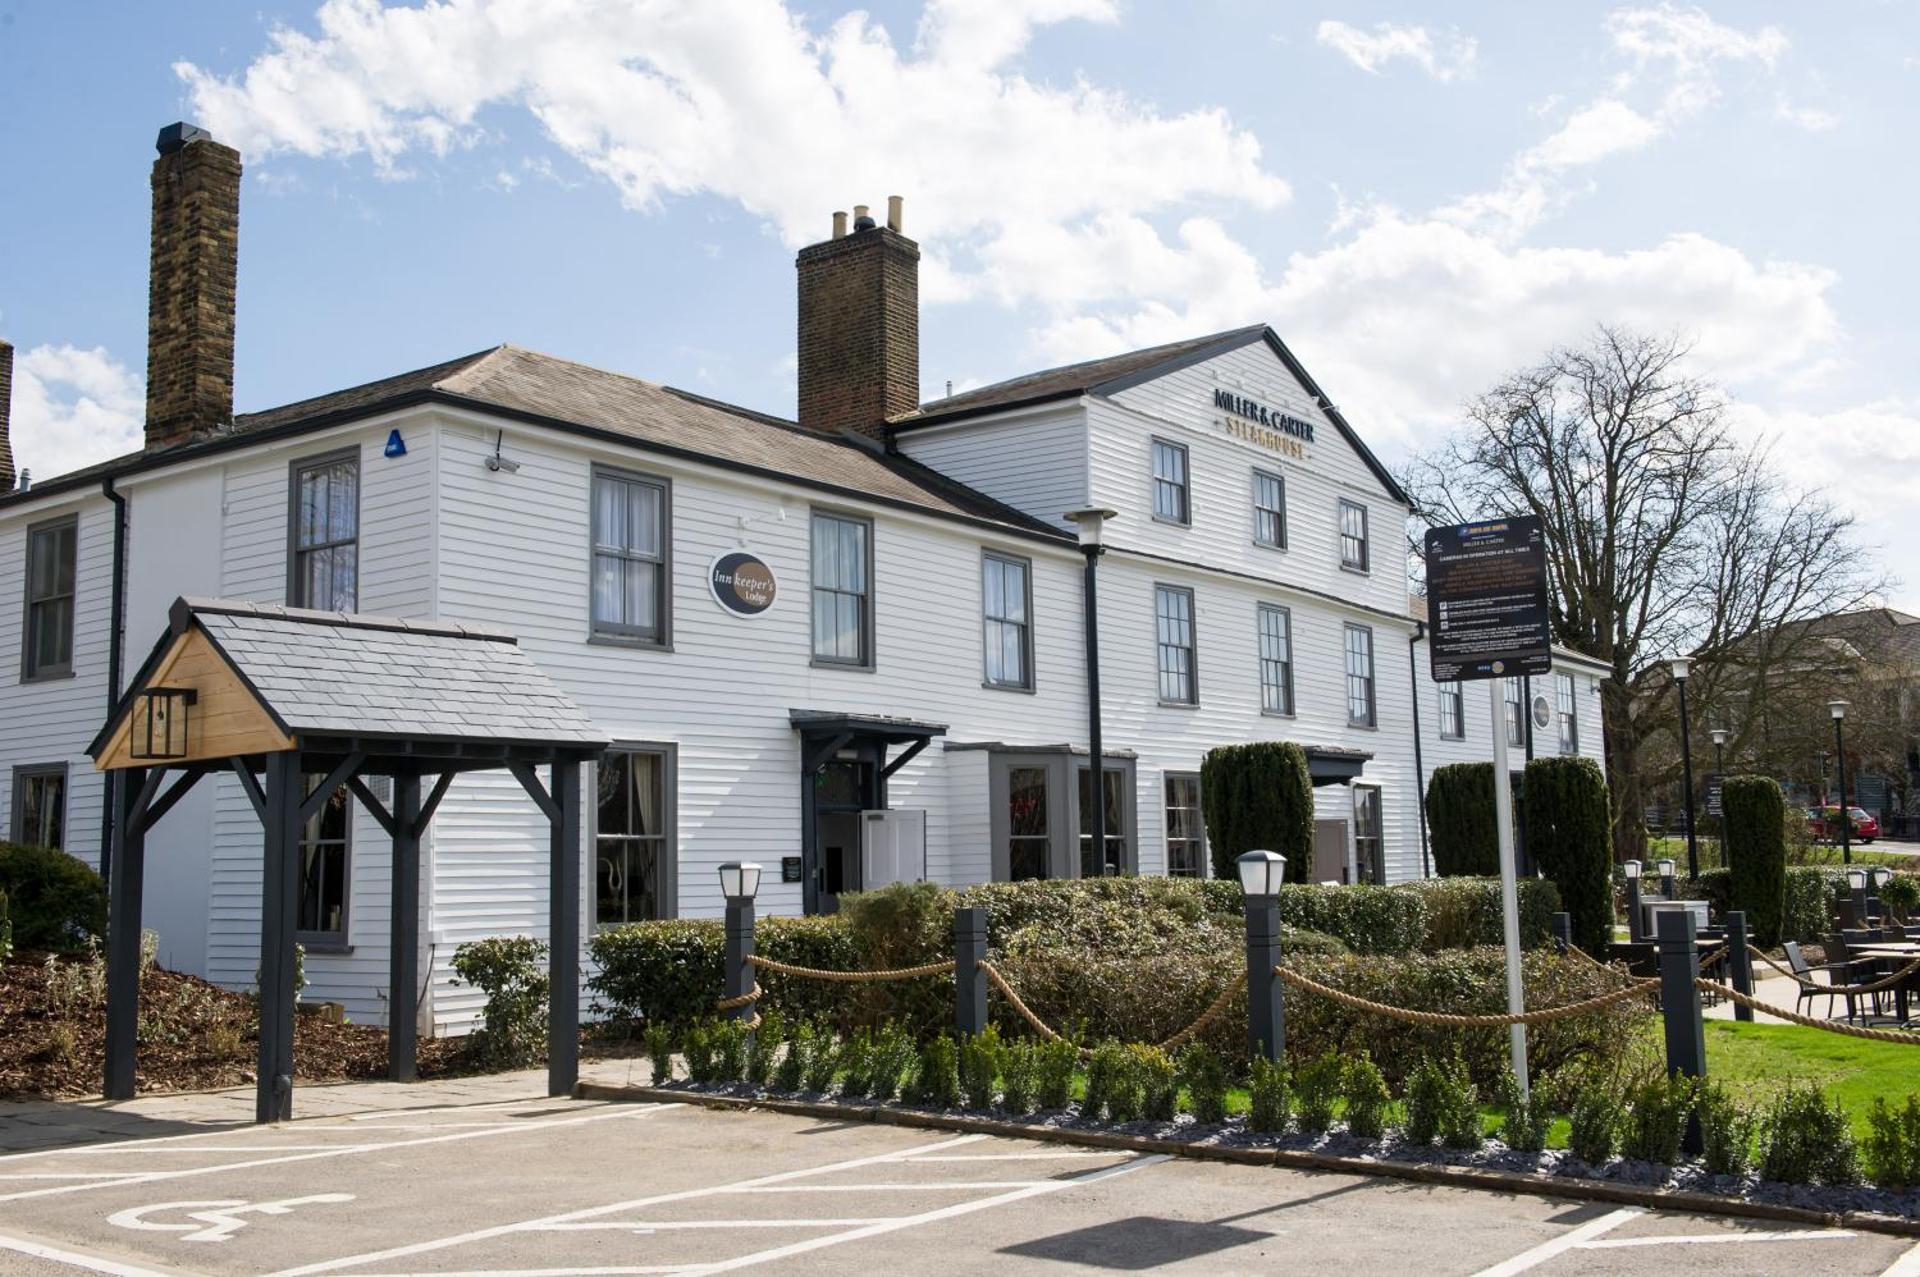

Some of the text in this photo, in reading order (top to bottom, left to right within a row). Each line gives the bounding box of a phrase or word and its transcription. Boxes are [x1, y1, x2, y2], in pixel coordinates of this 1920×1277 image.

[1215, 389, 1314, 443] MILLER & CARTER
[1225, 416, 1304, 460] STEAKHOUSE
